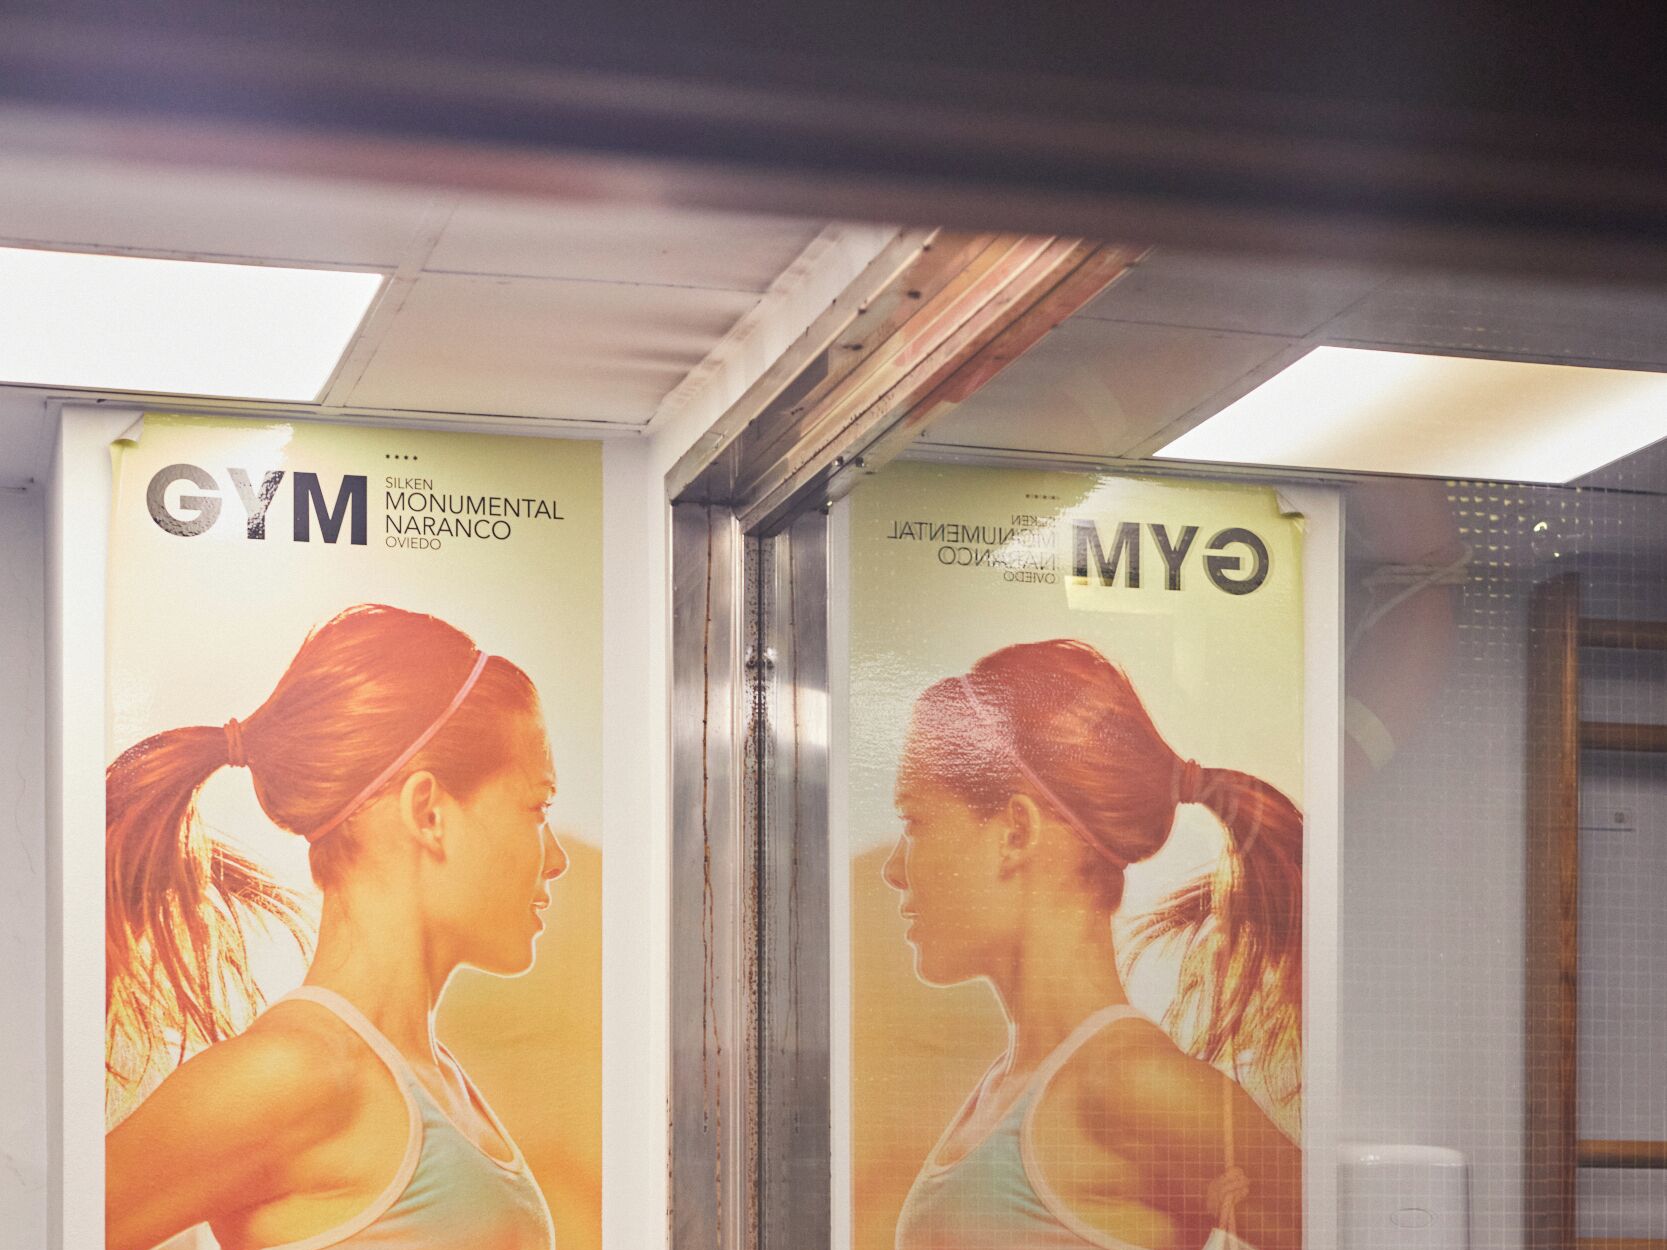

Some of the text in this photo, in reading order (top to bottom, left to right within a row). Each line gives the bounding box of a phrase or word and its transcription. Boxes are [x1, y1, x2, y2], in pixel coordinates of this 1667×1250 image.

[385, 476, 433, 490] SILKEN
[146, 463, 368, 546] GYM
[385, 492, 564, 520] MONUMENTAL
[385, 516, 512, 540] NARANCO
[385, 536, 442, 551] OVIEDO
